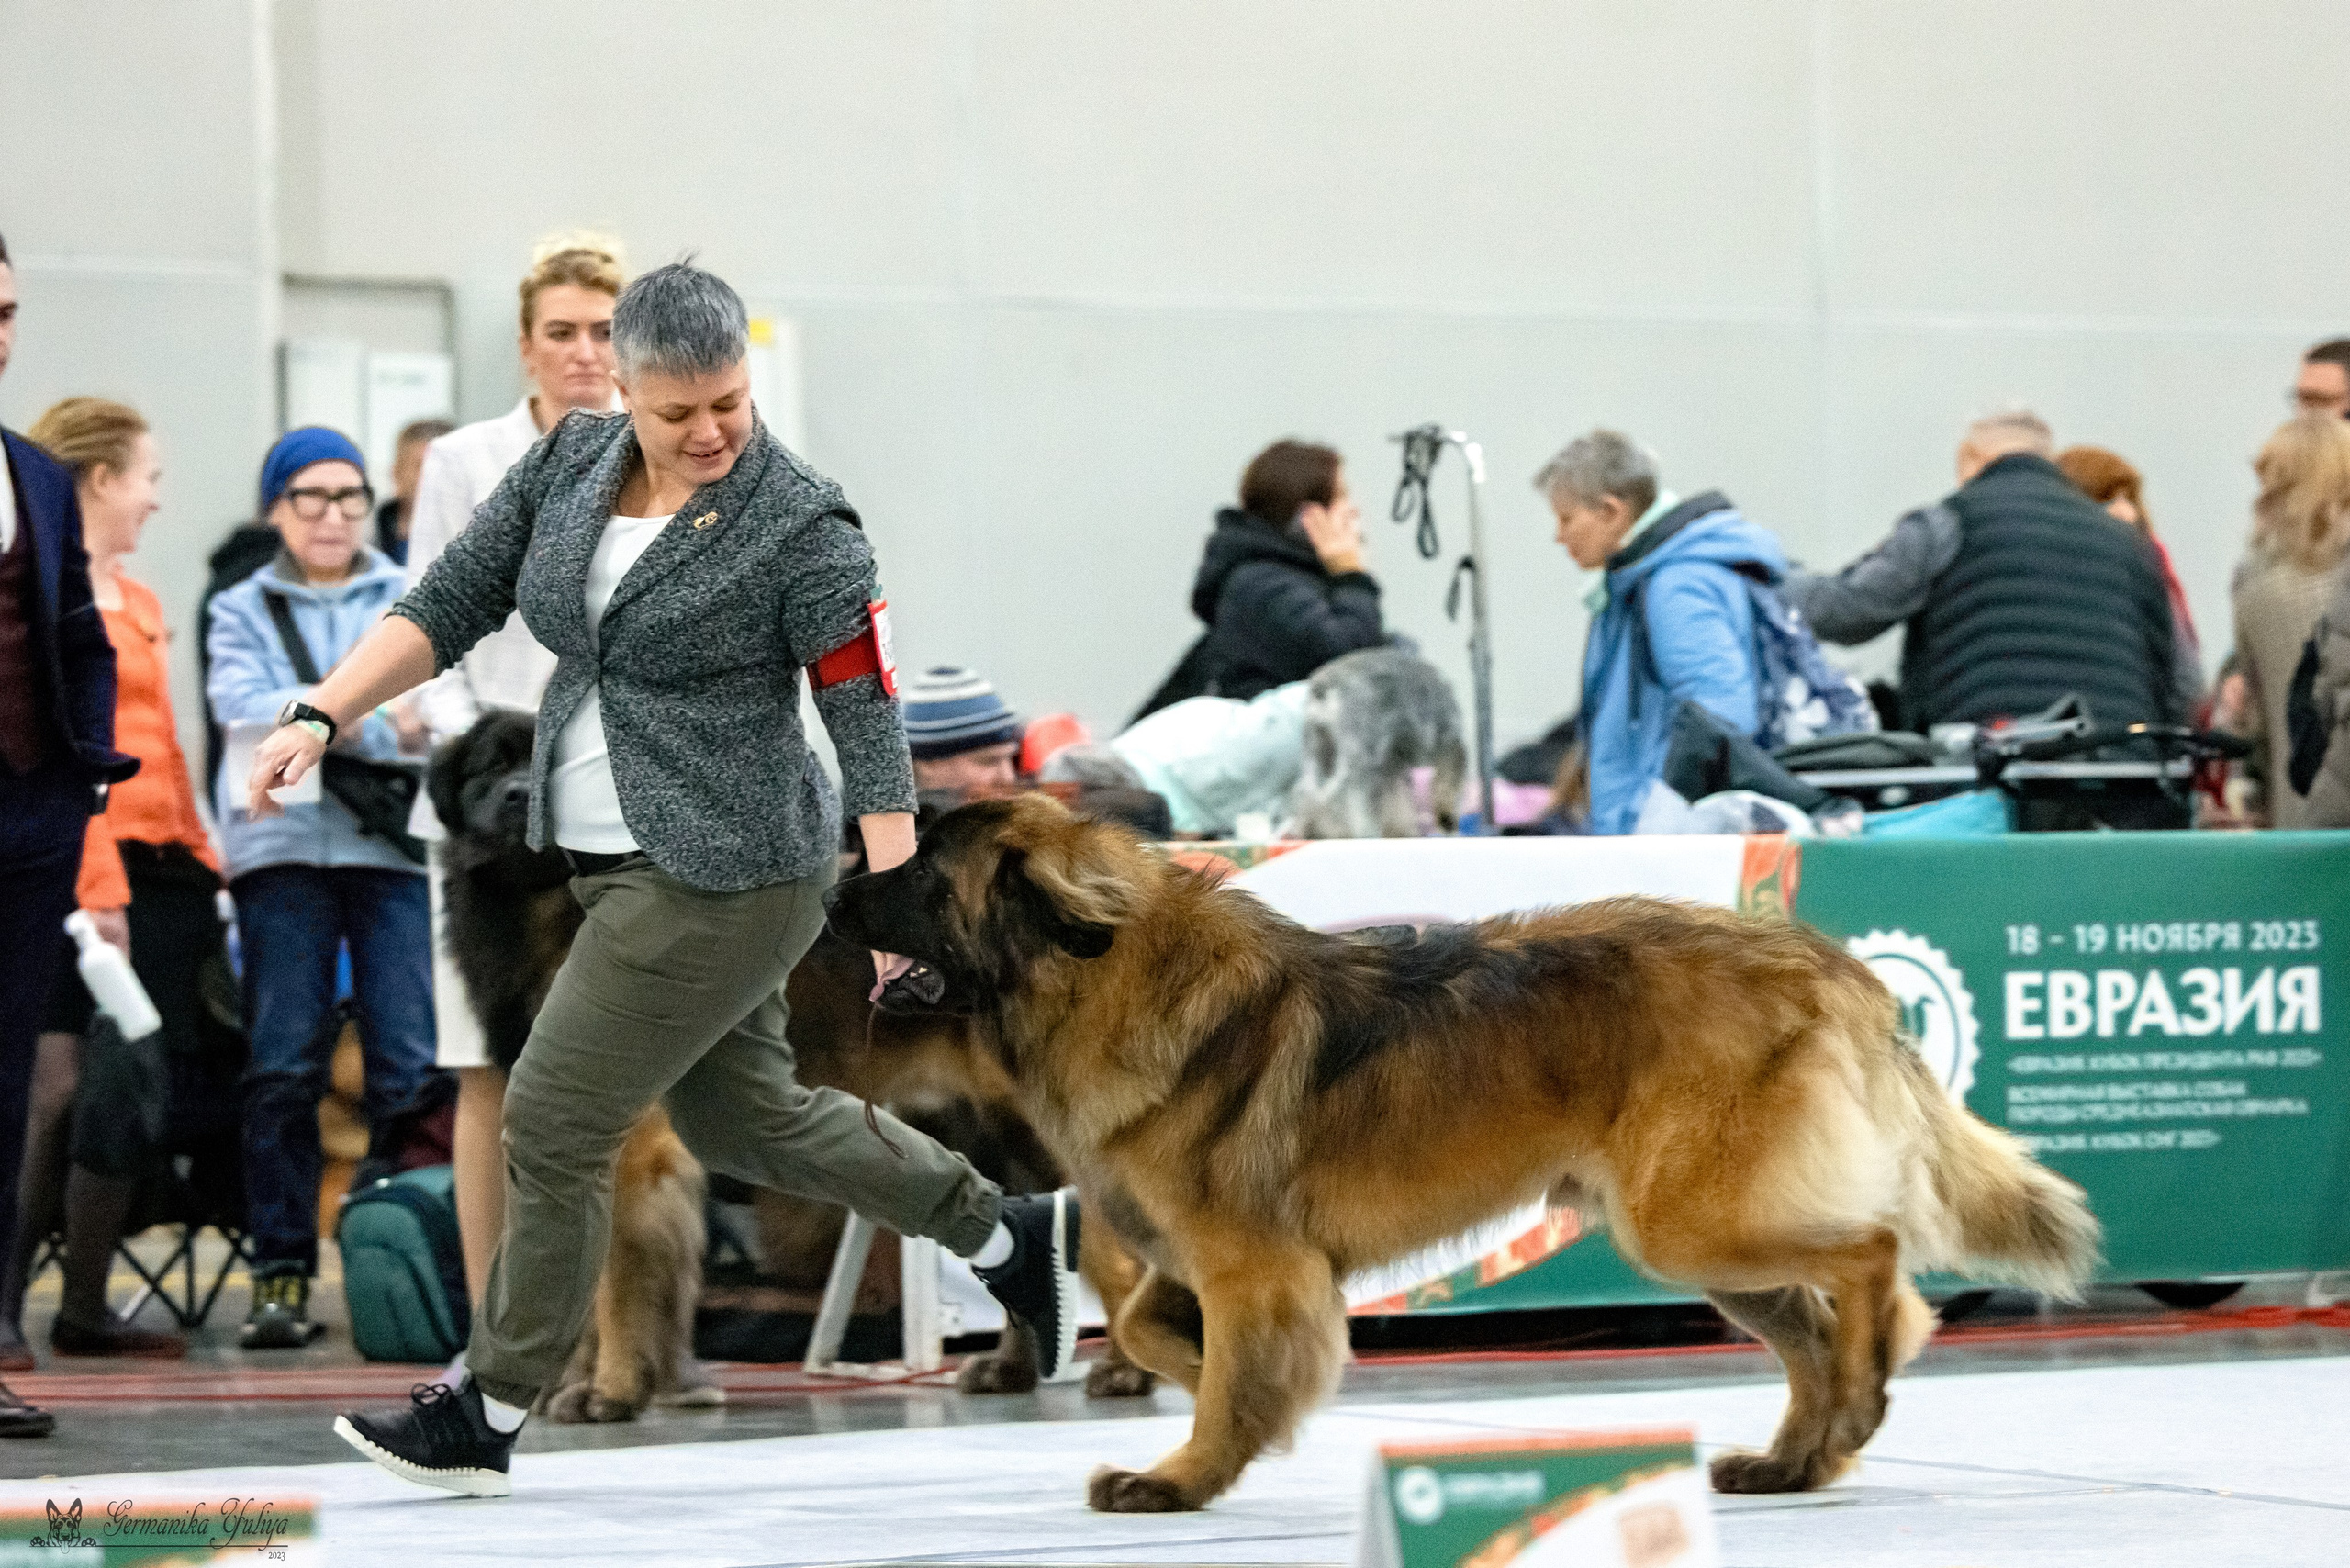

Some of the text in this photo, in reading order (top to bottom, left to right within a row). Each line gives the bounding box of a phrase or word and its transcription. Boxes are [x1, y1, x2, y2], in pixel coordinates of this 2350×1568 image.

[2007, 924, 2040, 956] 18
[2075, 923, 2108, 954] 19
[2115, 922, 2241, 953] НОЯБРЯ
[2250, 920, 2320, 951] 2023
[2005, 966, 2321, 1039] ЕВРАЗИЯ
